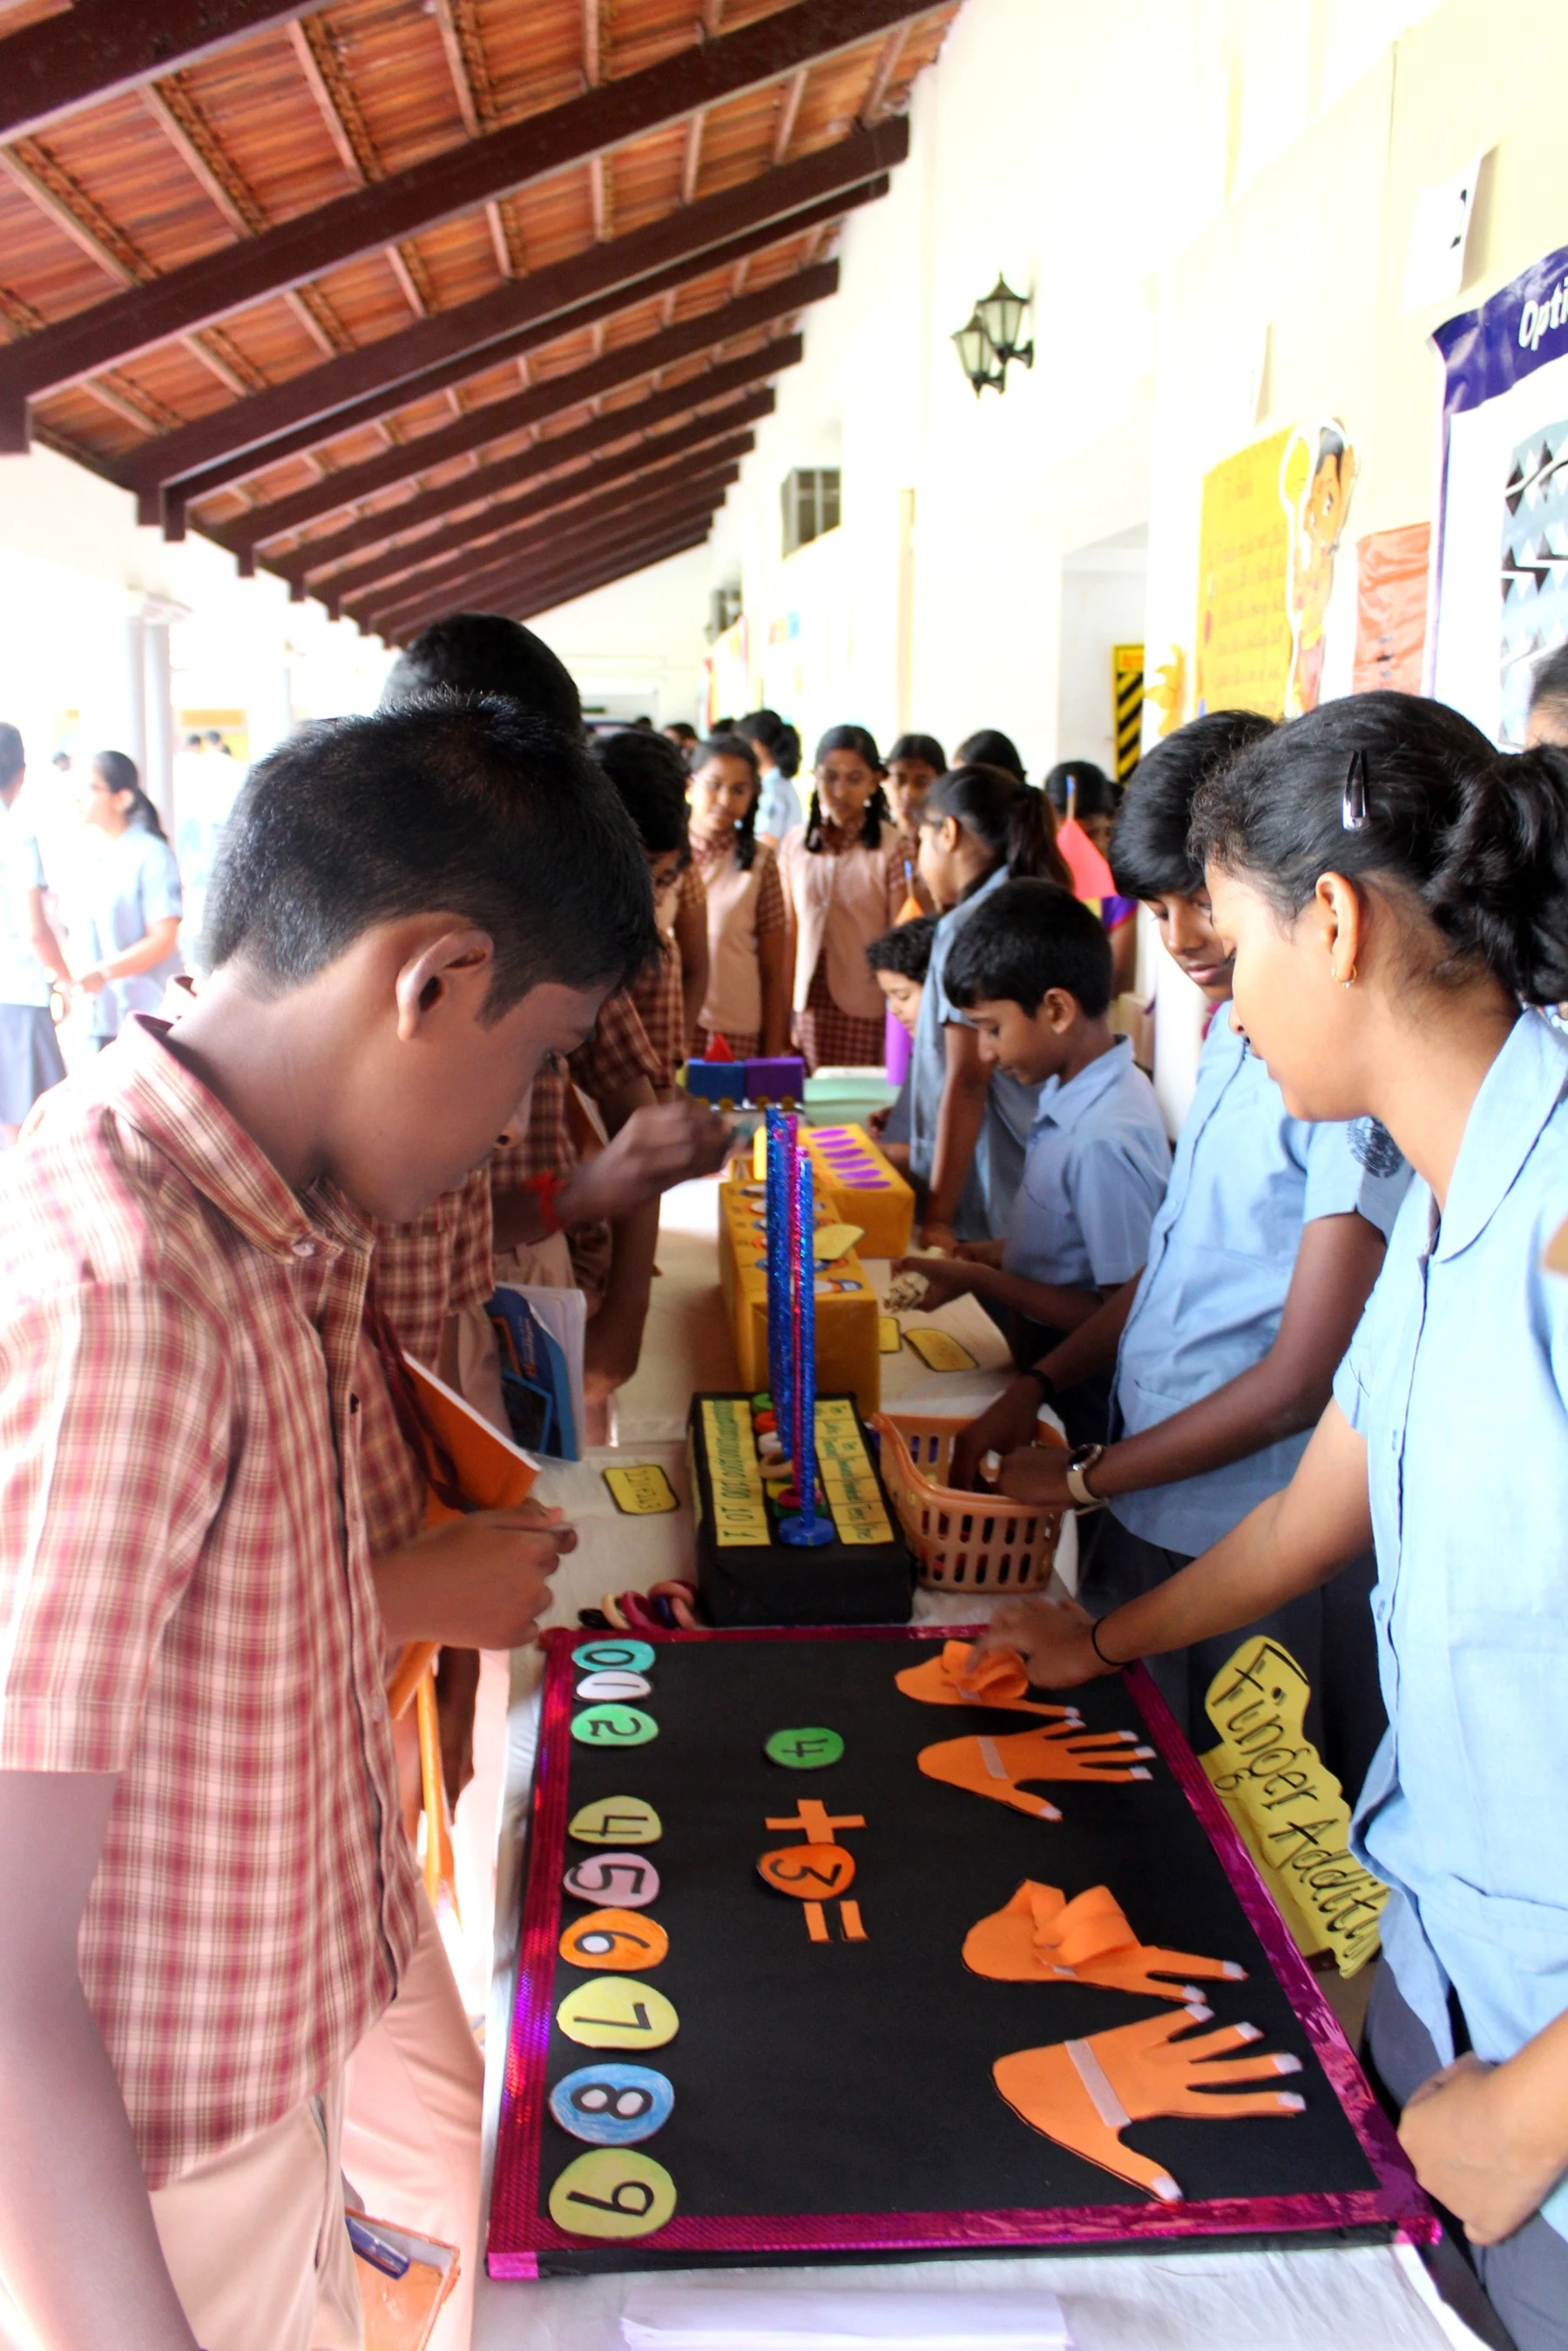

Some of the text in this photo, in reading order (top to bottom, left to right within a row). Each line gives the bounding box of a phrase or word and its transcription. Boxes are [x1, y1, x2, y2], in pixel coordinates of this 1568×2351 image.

[720, 1505, 754, 1522] 10
[583, 1647, 636, 1667] 0
[588, 1716, 642, 1737] 2
[1211, 1642, 1318, 1811] Finger
[781, 1738, 829, 1758] 4
[574, 1814, 649, 1837] 4
[569, 1863, 646, 1895] 5
[770, 1858, 842, 1887] 3
[573, 1929, 651, 1955] 6
[572, 2002, 652, 2030] 7
[570, 2082, 654, 2120] 8
[565, 2180, 654, 2218] 9
